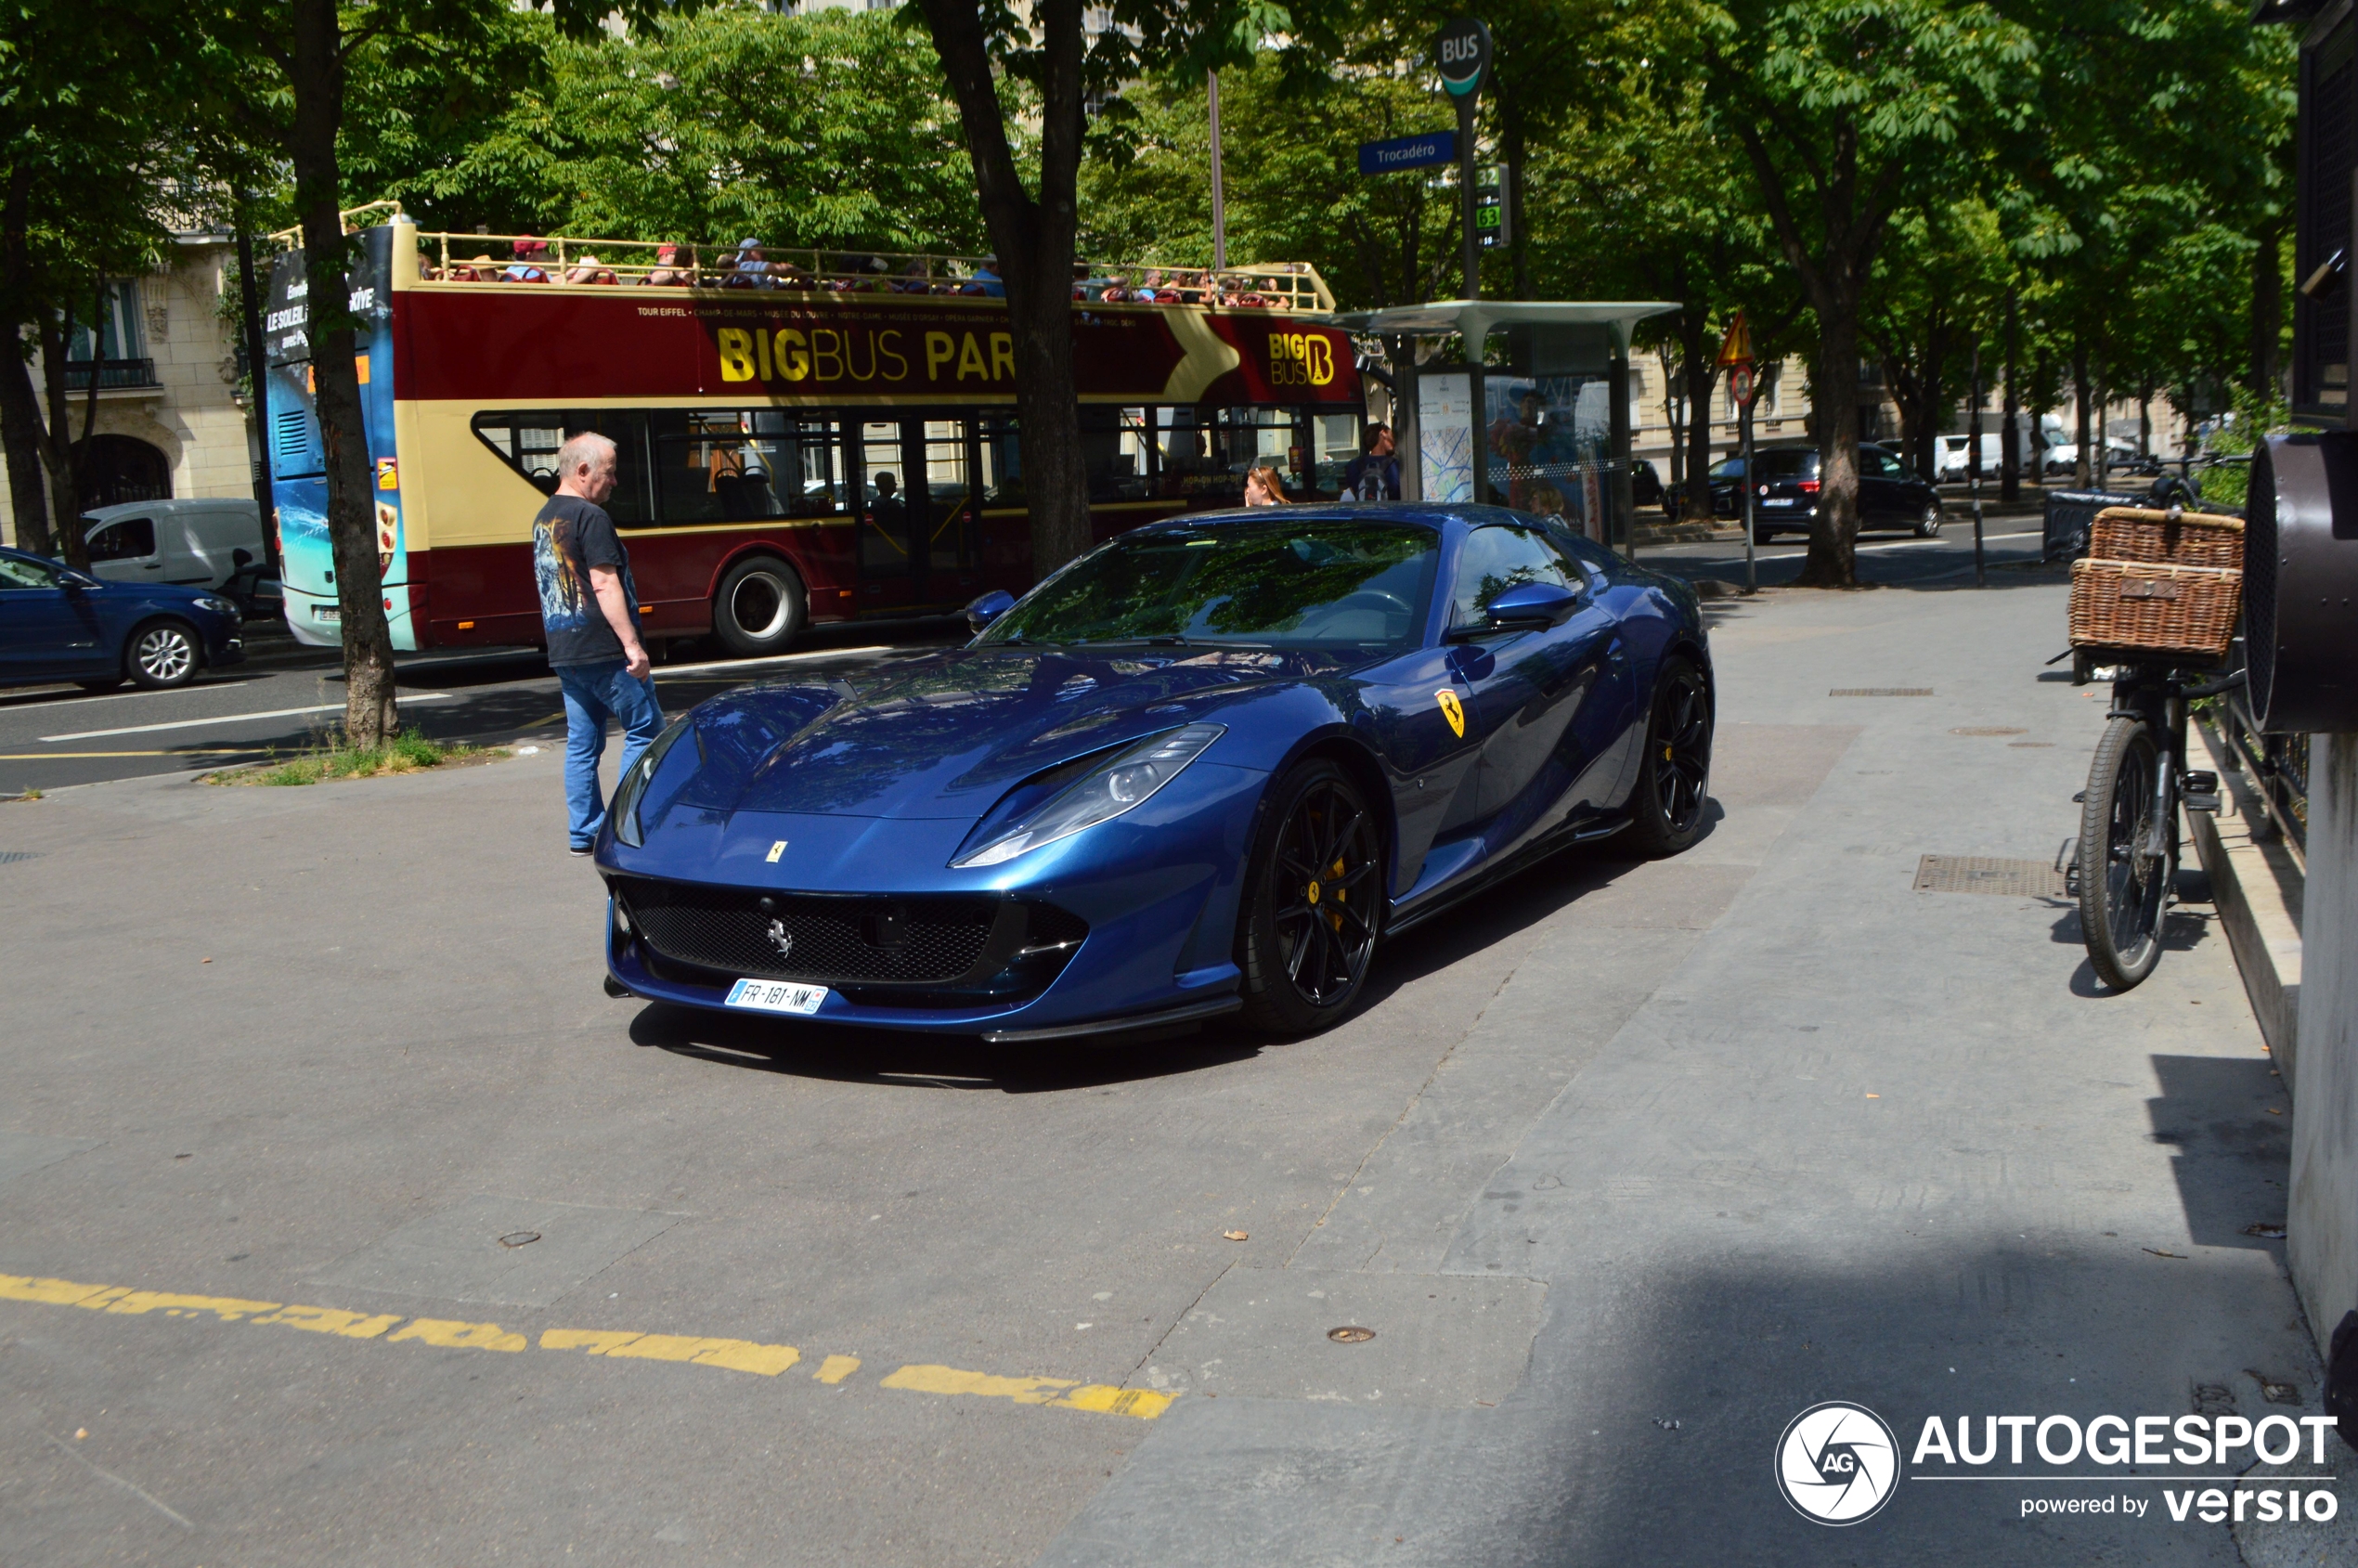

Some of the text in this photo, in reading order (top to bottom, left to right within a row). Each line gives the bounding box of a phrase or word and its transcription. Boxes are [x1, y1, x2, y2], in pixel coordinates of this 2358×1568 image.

[1442, 34, 1478, 63] BUS
[1377, 143, 1435, 163] Trocadéro
[1478, 167, 1496, 187] 32
[1479, 209, 1497, 226] 63
[266, 311, 279, 332] LE
[278, 305, 304, 330] SOLEIL
[638, 307, 659, 317] TOUR
[660, 307, 687, 317] EIFFEL
[693, 308, 757, 317] CHAMP-DE-MARS
[764, 308, 789, 317] MUSÉE
[790, 310, 800, 318] DU
[802, 310, 829, 319] LOUVRE
[837, 310, 882, 320] NOTRE-DAME
[925, 331, 1016, 382] PAR
[1268, 333, 1305, 360] BIG
[1271, 361, 1307, 384] BUS
[1183, 474, 1244, 485] HOP-ON HOP-OFF
[740, 984, 811, 1008] FR-181-NM
[805, 1001, 818, 1011] 92
